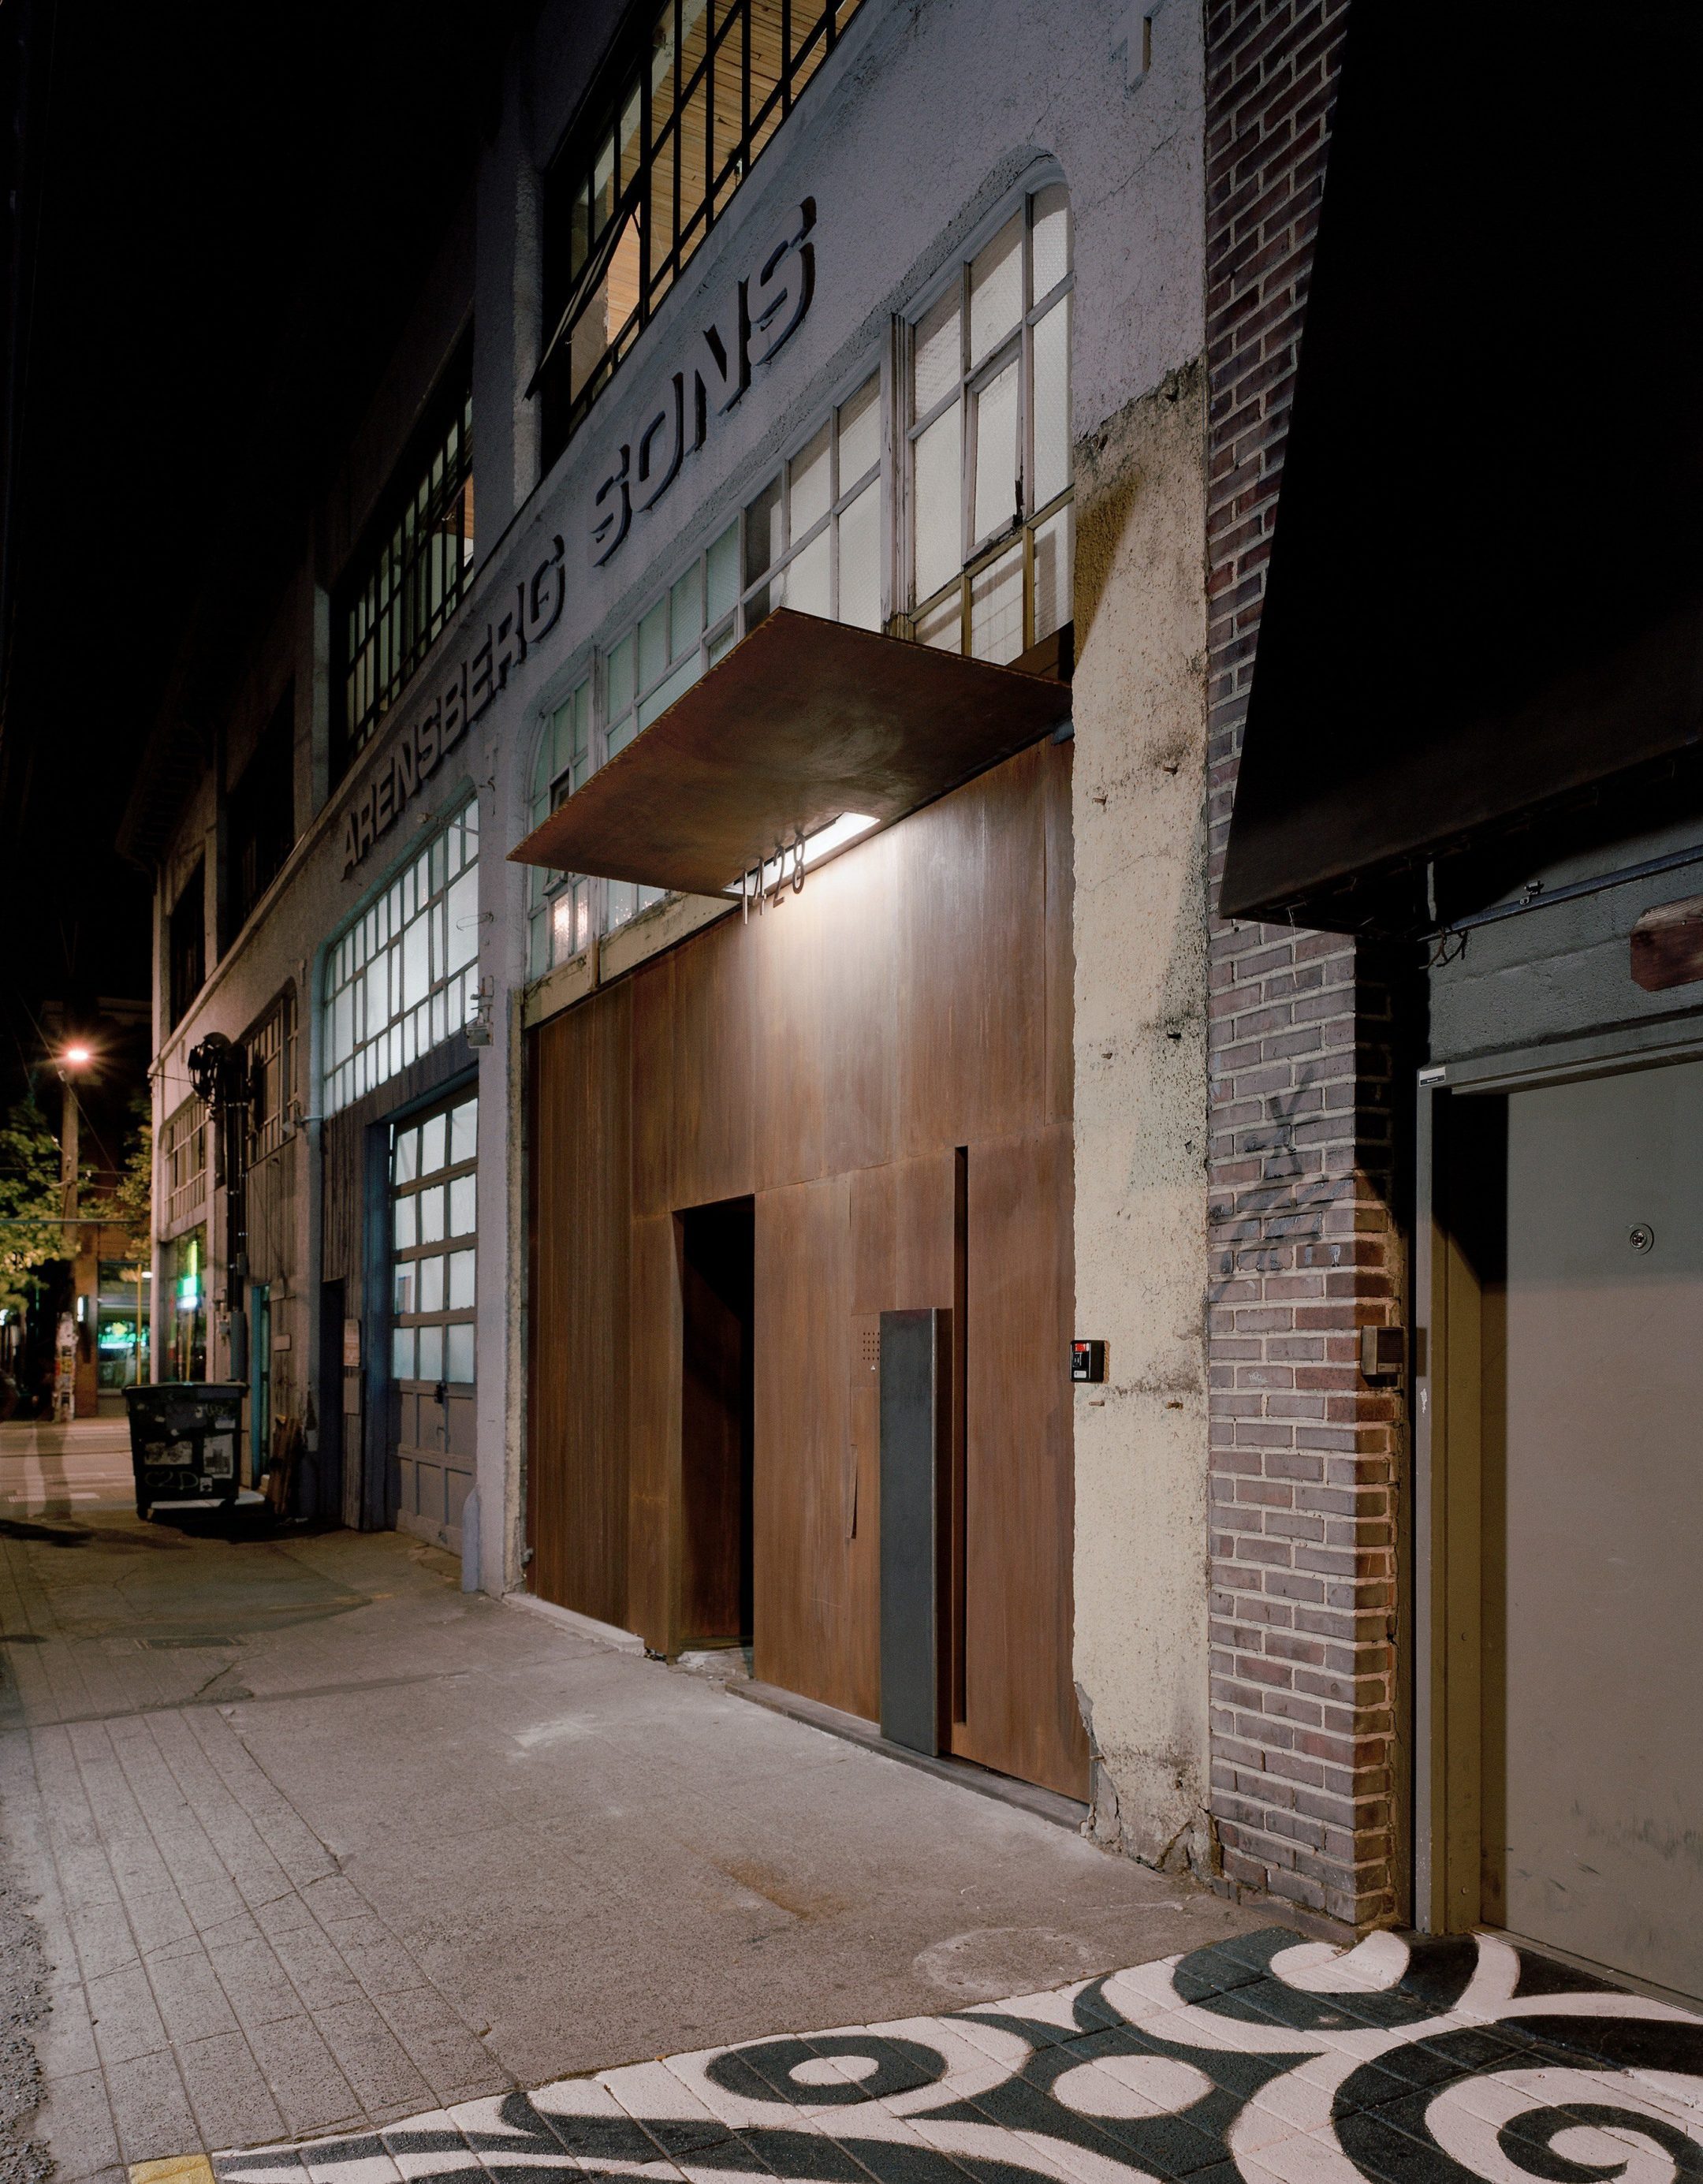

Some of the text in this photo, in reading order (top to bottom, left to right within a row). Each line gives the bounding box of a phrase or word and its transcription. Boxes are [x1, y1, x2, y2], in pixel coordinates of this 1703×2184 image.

[341, 196, 817, 881] ARENSBERG SONS
[741, 832, 806, 925] 1428
